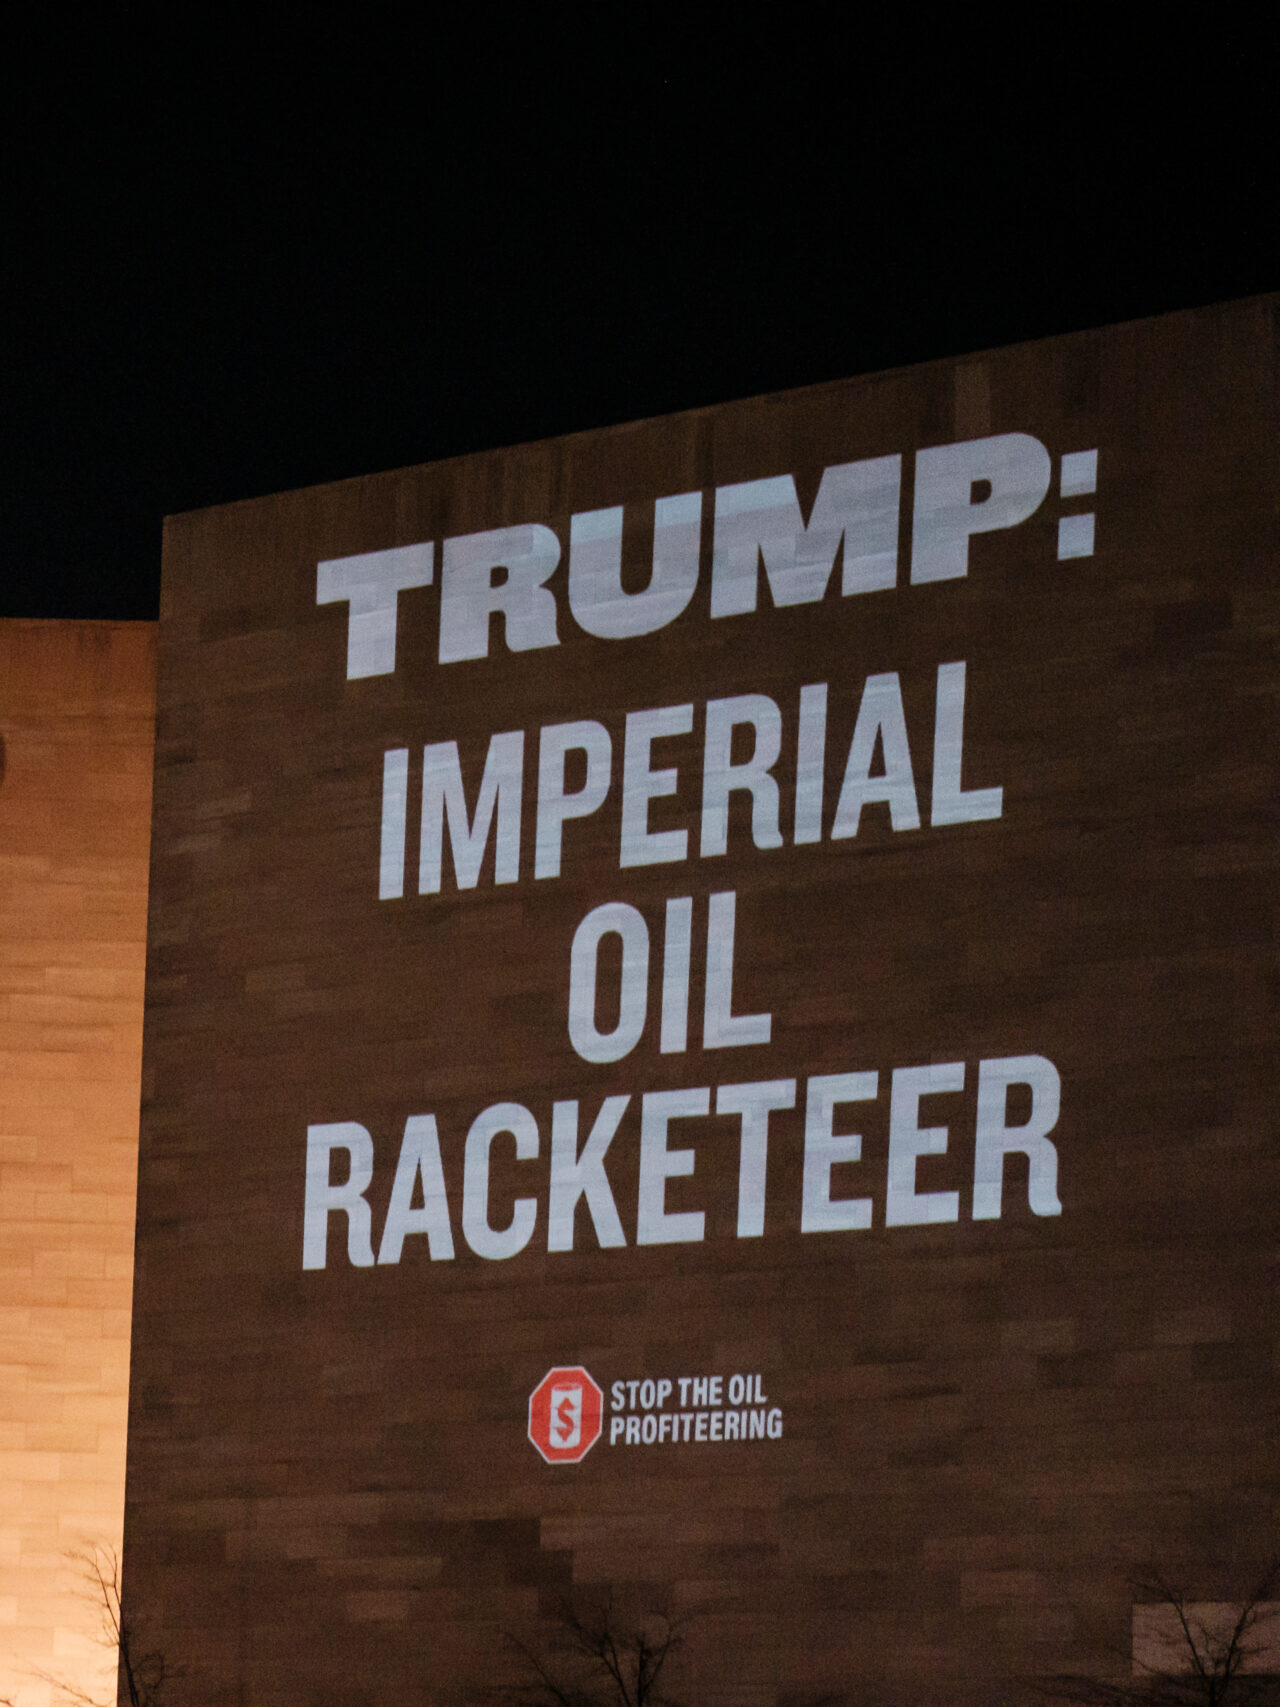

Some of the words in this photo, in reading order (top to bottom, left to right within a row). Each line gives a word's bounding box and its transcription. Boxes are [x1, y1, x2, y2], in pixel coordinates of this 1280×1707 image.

[316, 433, 1099, 680] TRUMP:
[378, 662, 1003, 899] IMPERIAL
[569, 892, 771, 1063] OIL
[303, 1055, 1062, 1269] RACKETEER
[609, 1407, 783, 1445] PROFITEERING
[610, 1379, 672, 1410] STOP
[677, 1375, 723, 1406] THE
[728, 1373, 767, 1405] OIL
